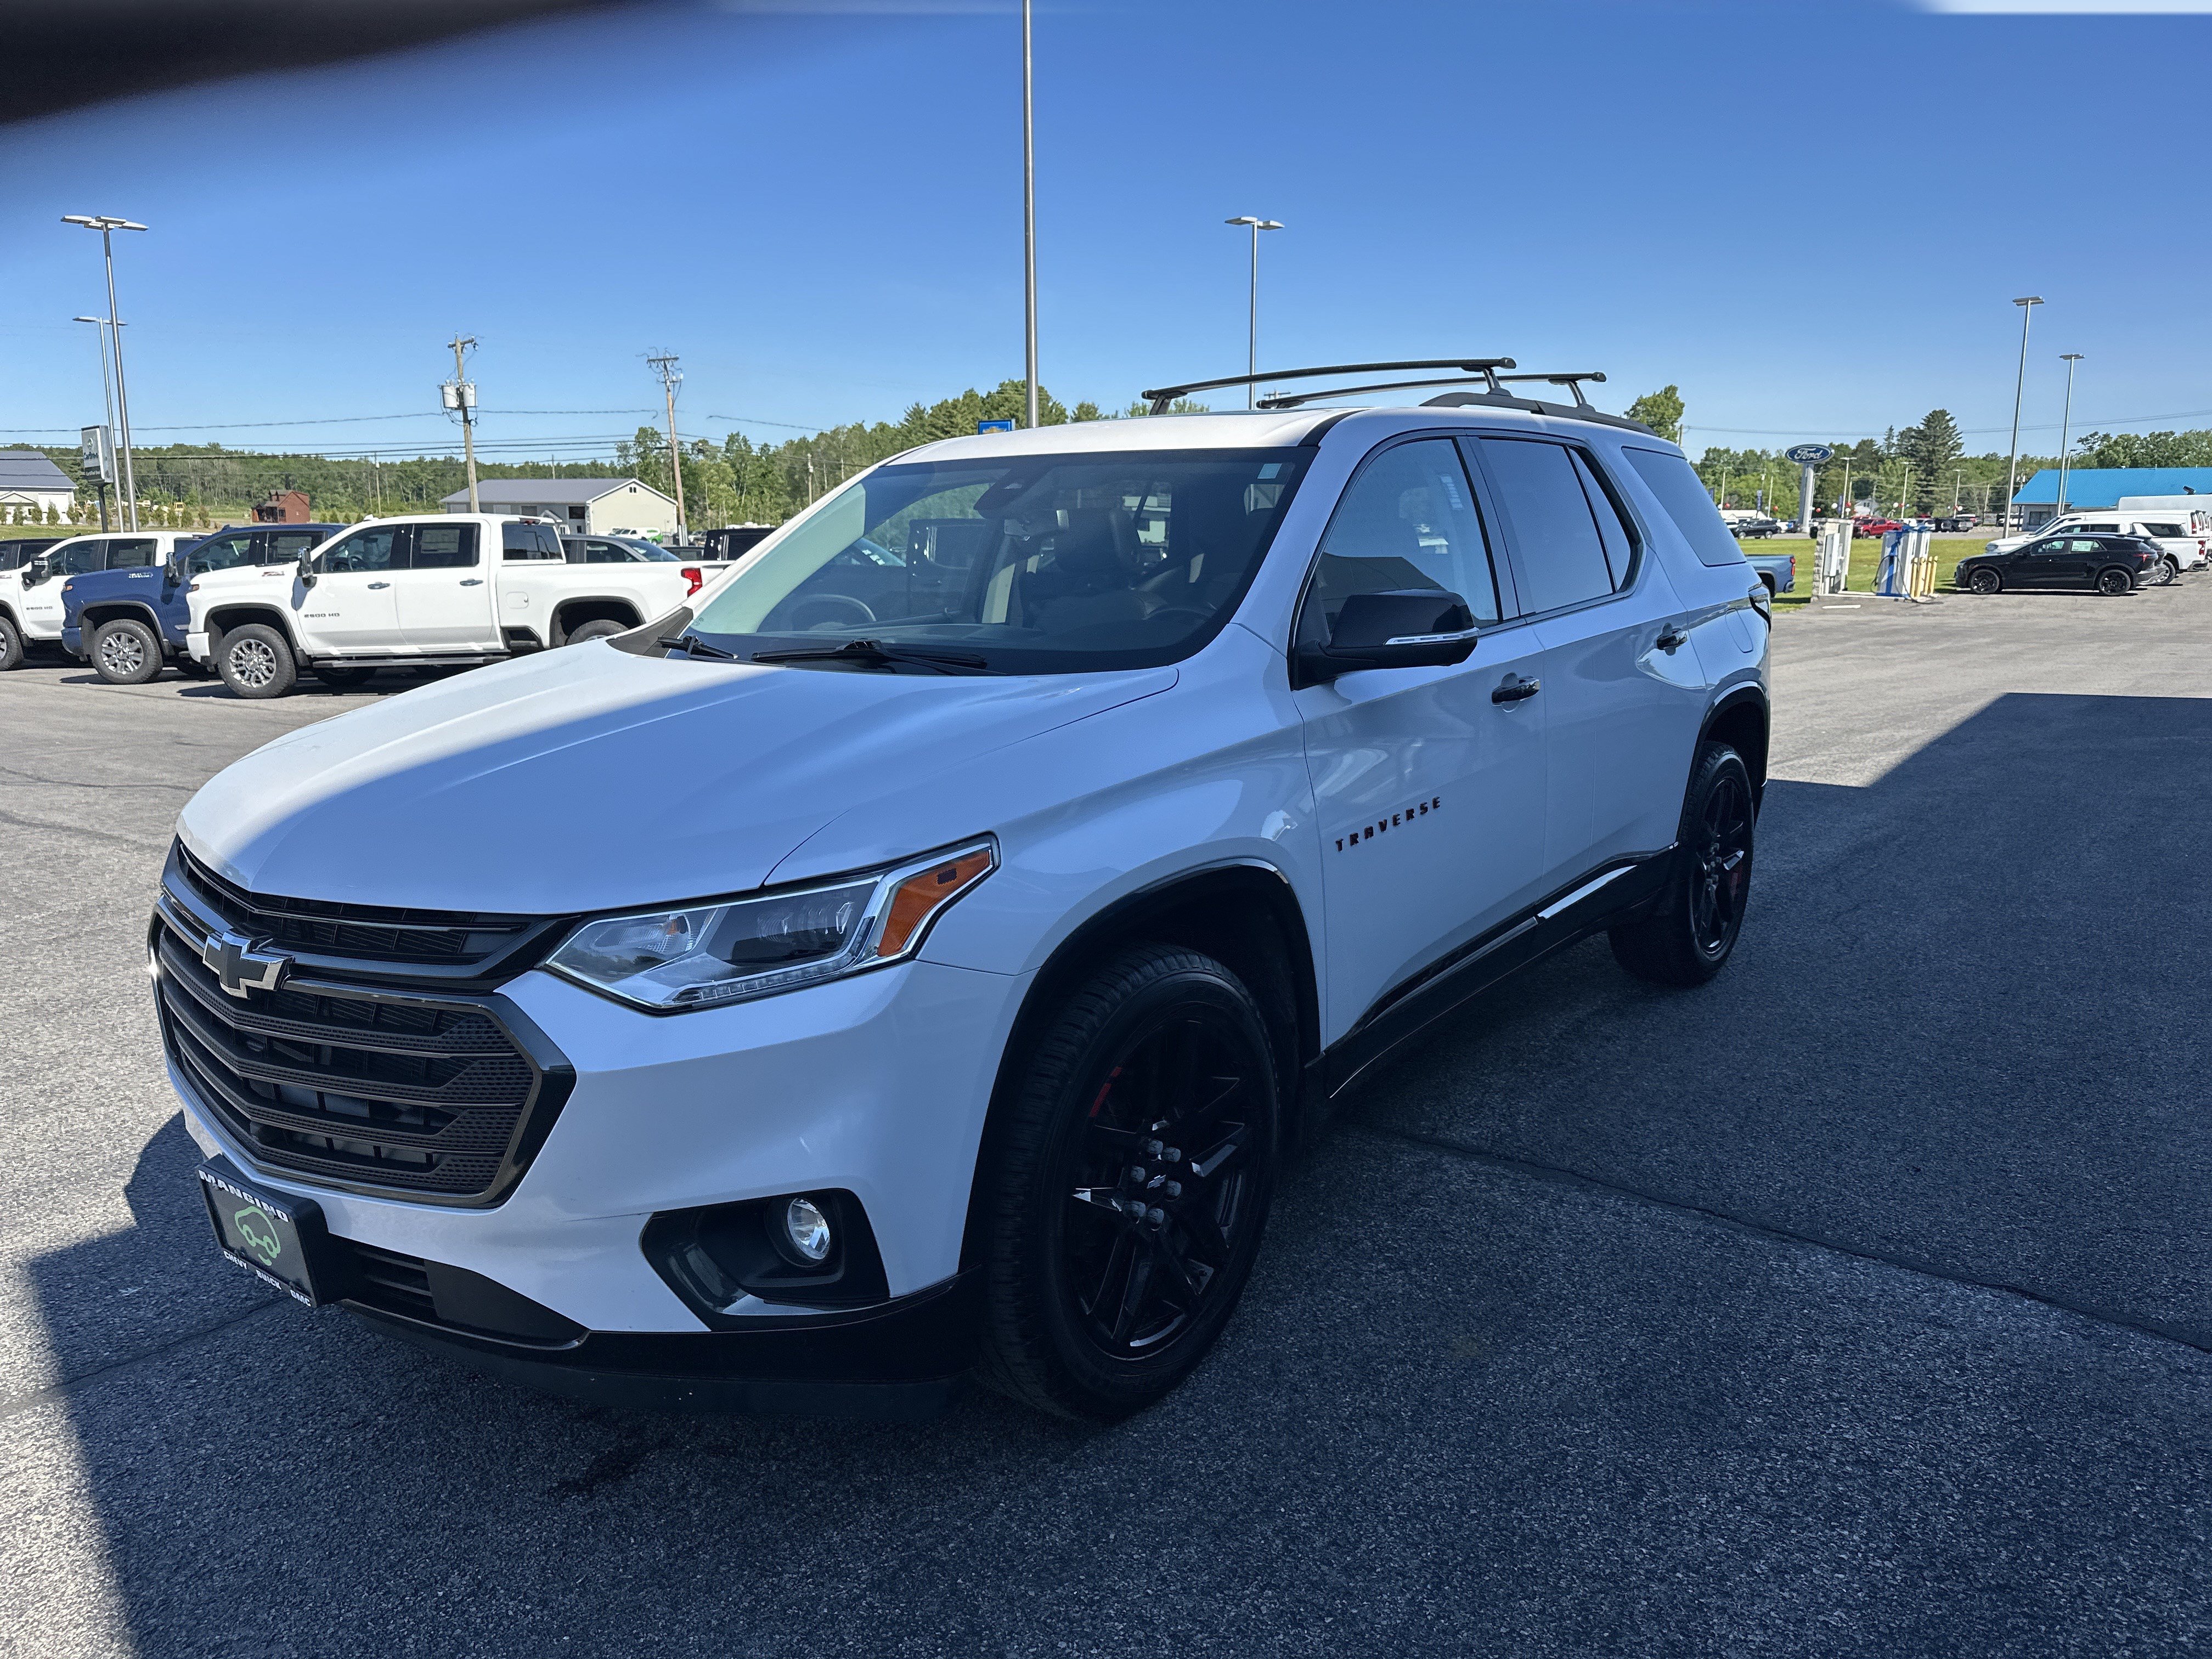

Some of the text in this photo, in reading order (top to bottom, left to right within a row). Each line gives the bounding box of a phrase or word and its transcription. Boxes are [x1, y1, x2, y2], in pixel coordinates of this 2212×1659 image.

[1794, 448, 1823, 459] Ford
[1335, 796, 1441, 852] TRAVERSE
[198, 1170, 289, 1222] MANGINO
[223, 1250, 311, 1307] CHEVY BUICK GMC
